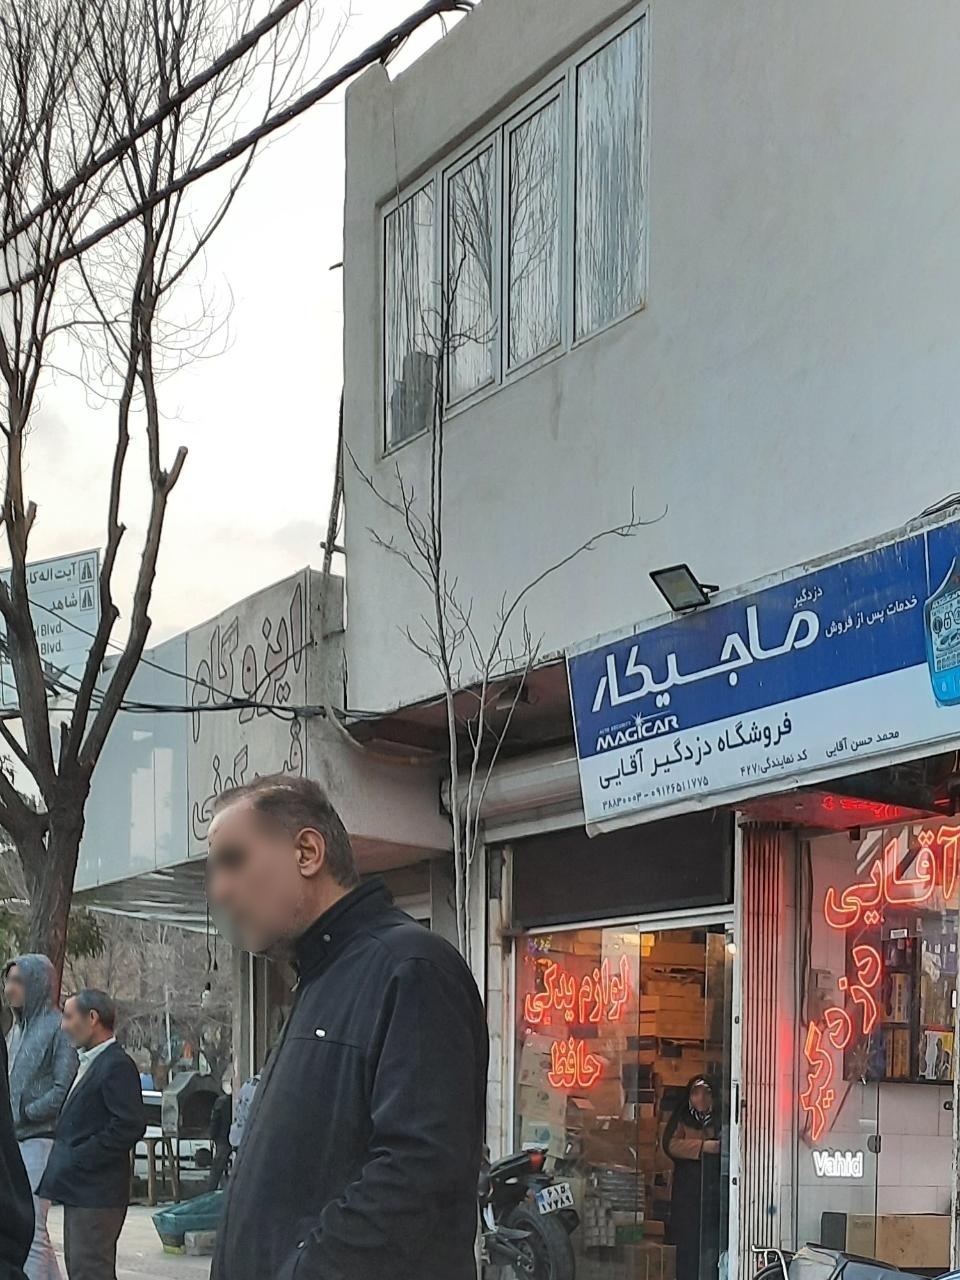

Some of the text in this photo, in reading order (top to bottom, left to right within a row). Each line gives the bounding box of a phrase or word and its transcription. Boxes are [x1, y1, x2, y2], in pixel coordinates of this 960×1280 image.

[50, 593, 78, 611] شاهد
[793, 586, 823, 609] دزدگیر
[886, 595, 918, 616] خدمات
[825, 616, 854, 637] فروش
[856, 612, 864, 628] از
[866, 609, 884, 626] پس
[592, 605, 821, 714] ماجیکار
[596, 715, 679, 751] MAGICAR
[826, 730, 900, 757] محمد حسن آقایی
[599, 712, 792, 789] فروشگاه دزدگیر آقایی
[797, 749, 808, 761] کد
[525, 954, 630, 1025] لوازم یدکی
[548, 1036, 602, 1087] حافظ
[812, 1151, 864, 1178] Vahid
